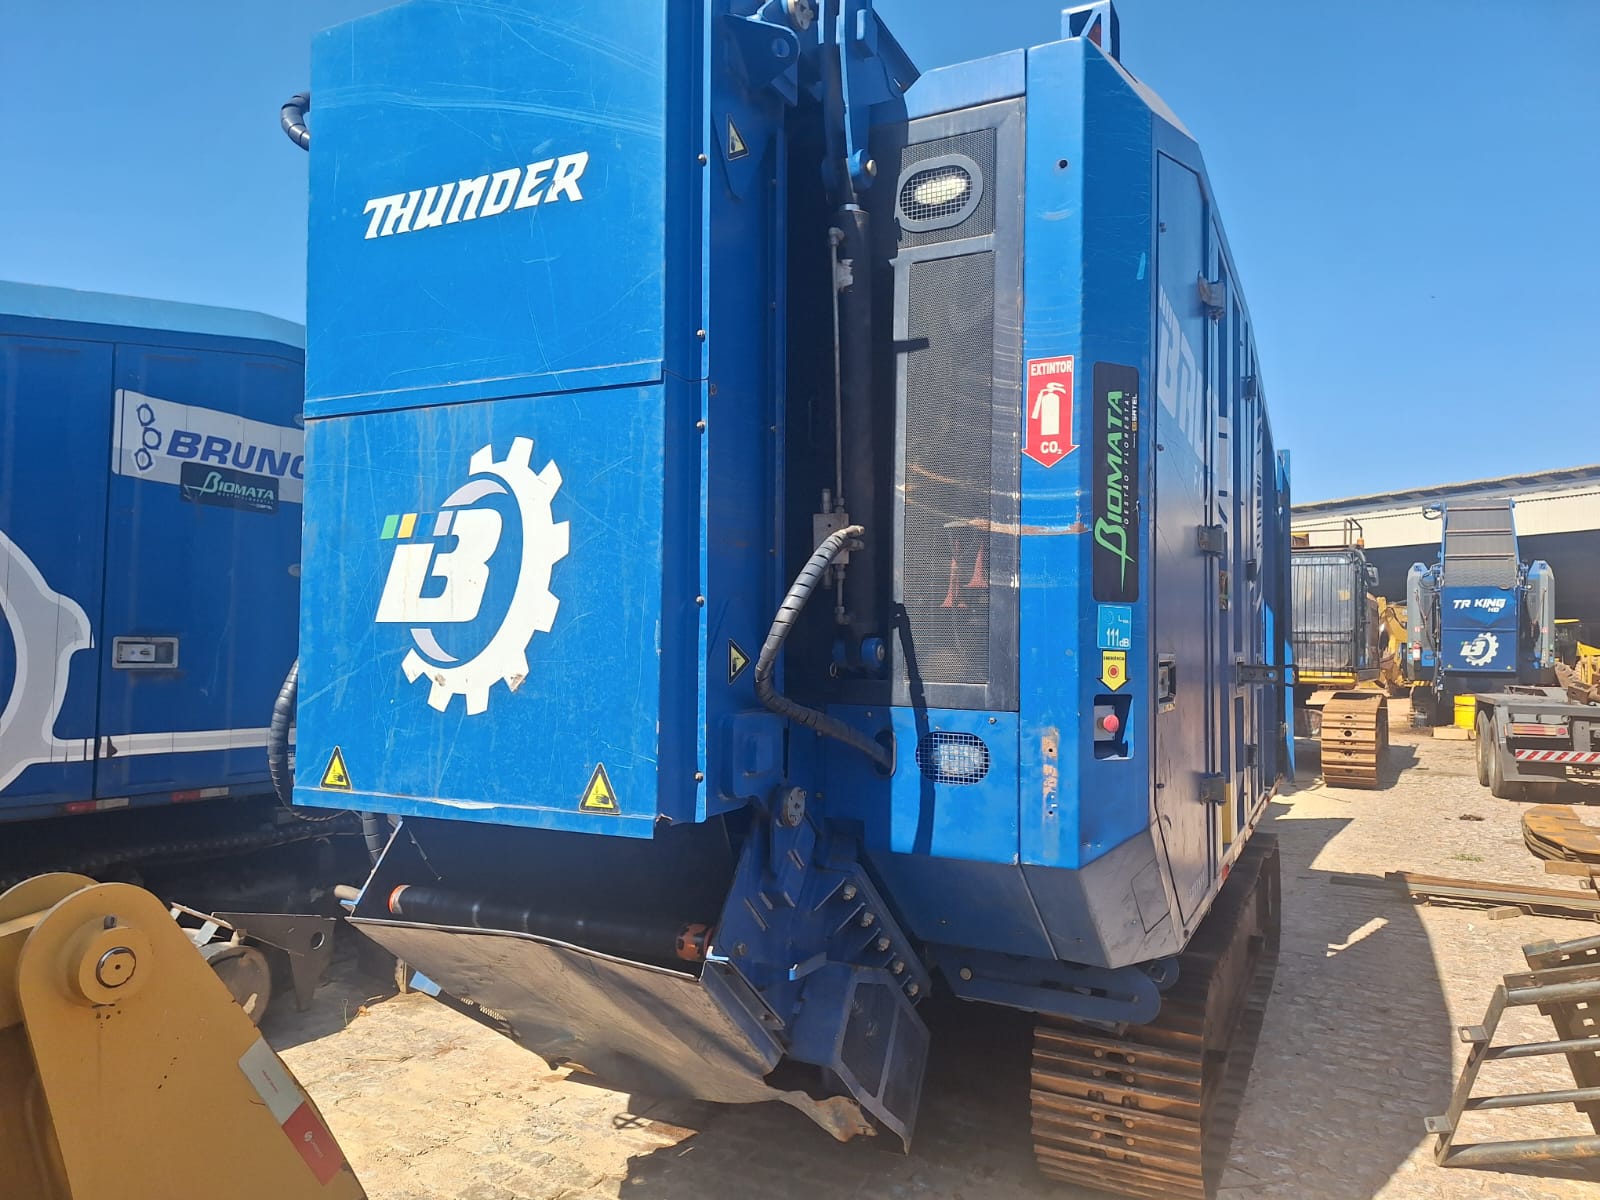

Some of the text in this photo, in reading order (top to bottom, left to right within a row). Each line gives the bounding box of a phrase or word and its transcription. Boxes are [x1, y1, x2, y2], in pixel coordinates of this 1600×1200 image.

[363, 151, 589, 240] THUNDER
[1030, 360, 1073, 376] EXTINTOR
[1123, 392, 1131, 465] FLORESTAL
[186, 471, 274, 501] BIOMATA
[1093, 390, 1135, 592] BIOMATA
[1453, 598, 1506, 609] TR KING
